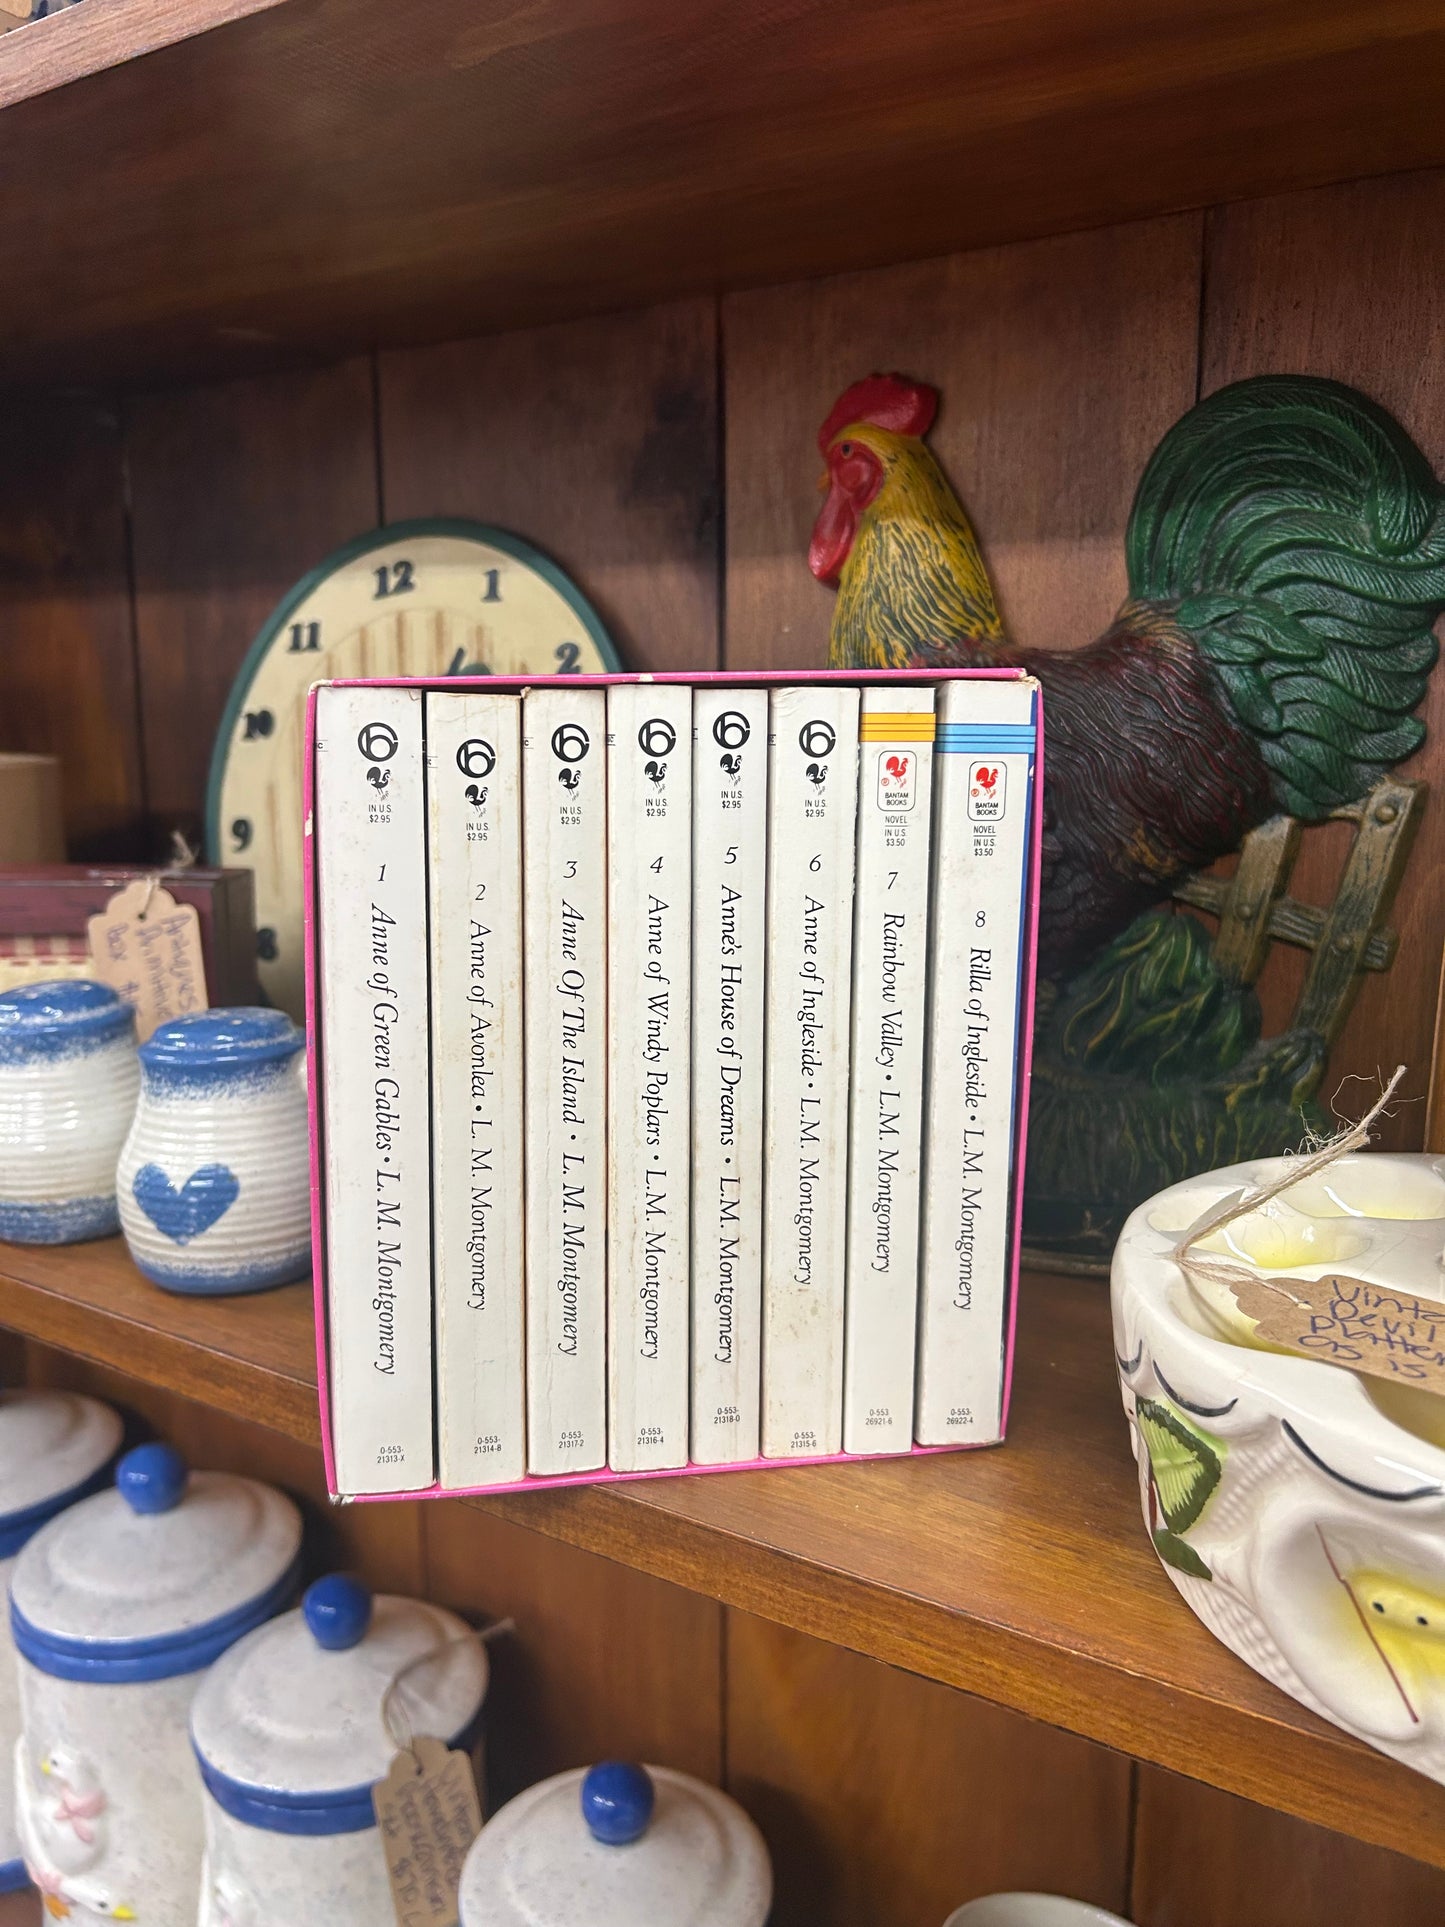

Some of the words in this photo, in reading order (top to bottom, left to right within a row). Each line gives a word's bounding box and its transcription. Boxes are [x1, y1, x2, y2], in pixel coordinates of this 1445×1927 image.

[372, 560, 417, 598] 12
[483, 569, 503, 601] 1
[287, 622, 322, 652] 11
[554, 642, 582, 675] 2
[242, 710, 274, 739] 10
[369, 804, 377, 812] IN
[647, 808, 666, 817] $2.95
[722, 800, 741, 809] $2.95
[806, 809, 825, 818] $2.95
[370, 814, 391, 824] $2.95
[466, 823, 474, 831] IN
[561, 816, 581, 825] $2.95
[885, 816, 907, 824] NOVEL
[885, 829, 893, 837] IN
[974, 826, 996, 834] NOVEL
[232, 819, 253, 853] 9
[467, 833, 488, 841] $2.95
[886, 838, 905, 847] $3.50
[650, 857, 663, 873] 4
[724, 847, 738, 864] 5
[810, 854, 821, 871] 6
[975, 848, 993, 856] $3.50
[378, 864, 386, 881] 1
[563, 861, 577, 878] 3
[888, 872, 898, 889] 7
[475, 884, 485, 900] 2
[562, 899, 584, 960] Anne
[649, 894, 669, 954] Anne
[722, 884, 742, 955] Anne's
[804, 895, 824, 954] Anne
[975, 911, 985, 927] 8
[257, 928, 277, 960] 8
[372, 903, 396, 965] Anne
[471, 920, 491, 978] Anne
[883, 913, 905, 1002] Rainbow
[644, 962, 670, 984] of
[799, 962, 824, 983] of
[970, 948, 991, 992] Rilla
[367, 973, 397, 998] of
[466, 986, 493, 1008] of
[557, 970, 584, 1002] Of
[721, 964, 742, 1030] House
[963, 999, 989, 1021] of
[373, 1003, 398, 1068] Green
[563, 1008, 585, 1048] The
[643, 992, 669, 1062] Windy
[797, 989, 823, 1076] Ingleside
[875, 1010, 902, 1067] Valley
[471, 1013, 493, 1098] Avonlea
[717, 1037, 742, 1059] of
[962, 1025, 988, 1107] Ingleside
[563, 1056, 584, 1124] Island
[375, 1079, 400, 1150] Gables
[642, 1071, 668, 1145] Poplars
[721, 1066, 741, 1145] Dreams
[472, 1120, 492, 1138] L.
[472, 1149, 492, 1177] M.
[563, 1152, 584, 1174] L.
[377, 1169, 400, 1191] L.
[563, 1183, 584, 1213] M.
[871, 1149, 899, 1272] Montgomery
[377, 1200, 401, 1230] M.
[794, 1158, 819, 1284] Montgomery
[466, 1187, 492, 1310] Montgomery
[953, 1188, 982, 1310] Montgomery
[557, 1222, 585, 1355] Montgomery
[640, 1231, 666, 1359] Montgomery
[714, 1237, 739, 1363] Montgomery
[373, 1240, 401, 1374] Montgomery
[714, 1416, 740, 1424] 21318-0
[865, 1416, 892, 1425] 26921-6
[946, 1417, 973, 1425] 26922-4
[474, 1444, 502, 1453] 21314-8
[558, 1439, 584, 1449] 21317-2
[637, 1436, 664, 1445] 21316-4
[790, 1440, 816, 1448] 21315-6
[377, 1454, 405, 1463] 21313-X
